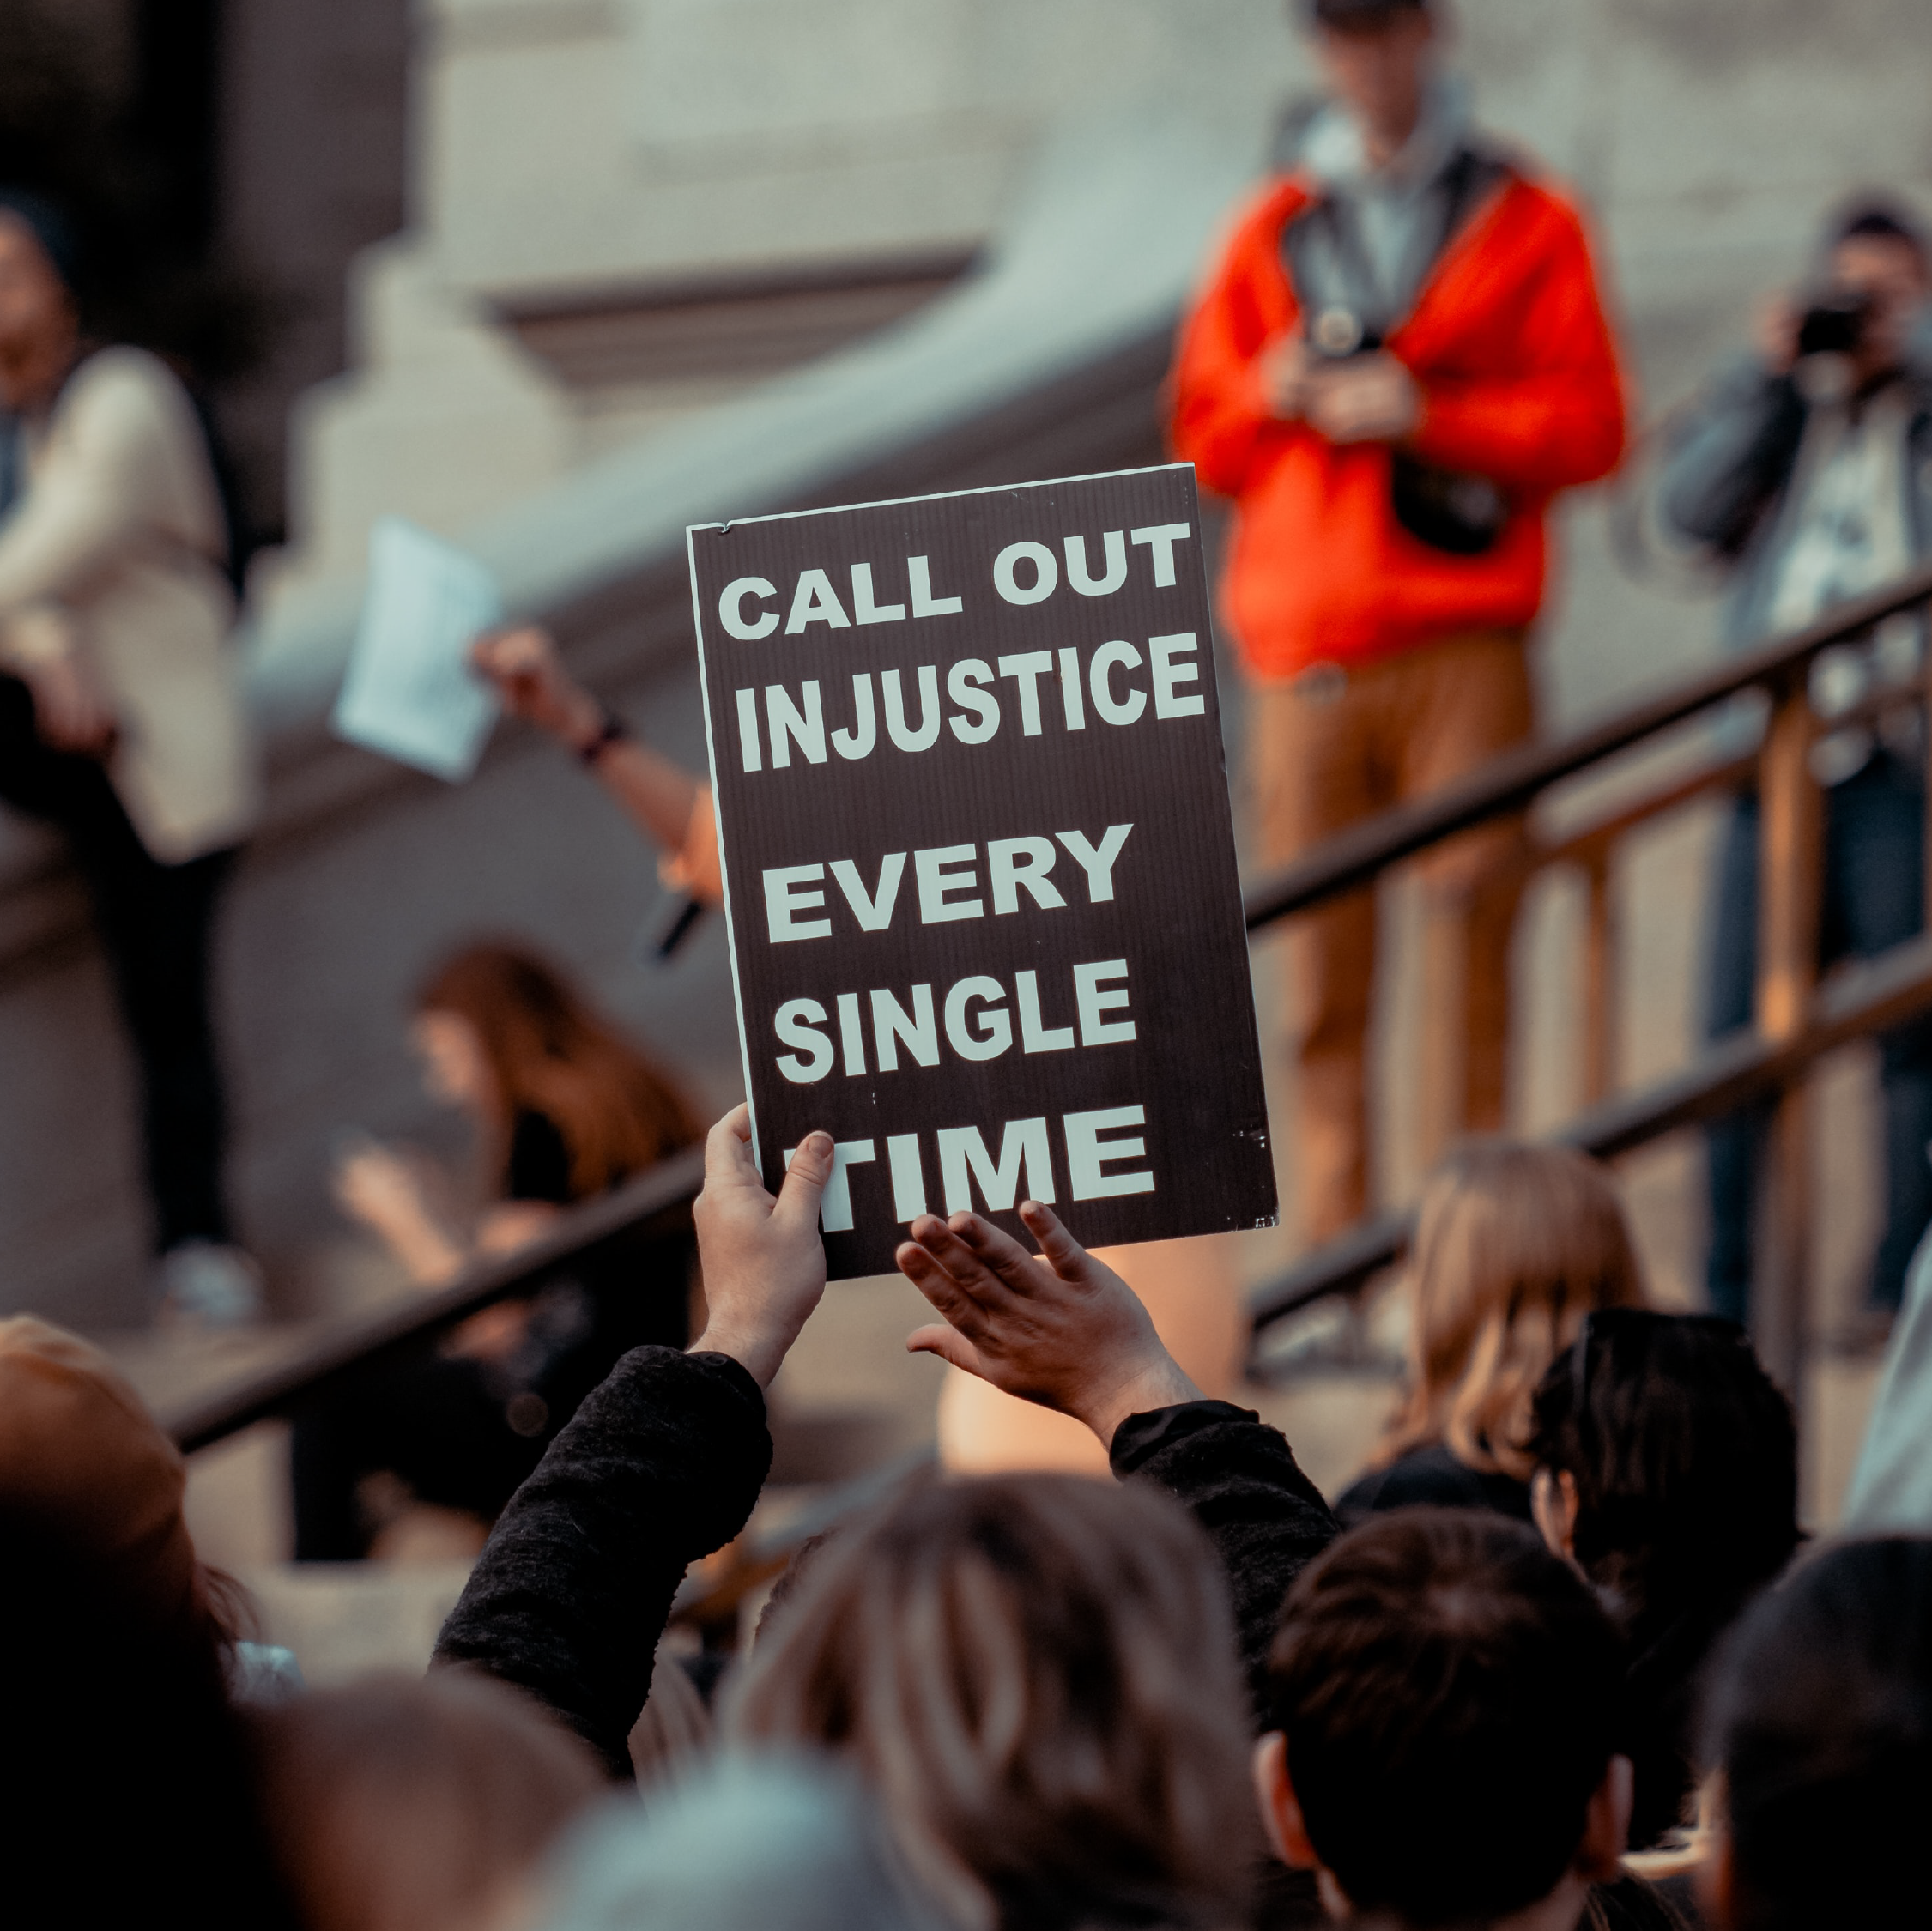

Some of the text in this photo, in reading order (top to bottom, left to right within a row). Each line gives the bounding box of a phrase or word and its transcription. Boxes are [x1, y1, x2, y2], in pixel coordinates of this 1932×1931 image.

[718, 522, 1191, 640] CALL OUT
[736, 632, 1205, 772] INJUSTICE
[762, 823, 1134, 943] EVERY
[774, 959, 1137, 1083] SINGLE
[784, 1105, 1155, 1232] TIME
